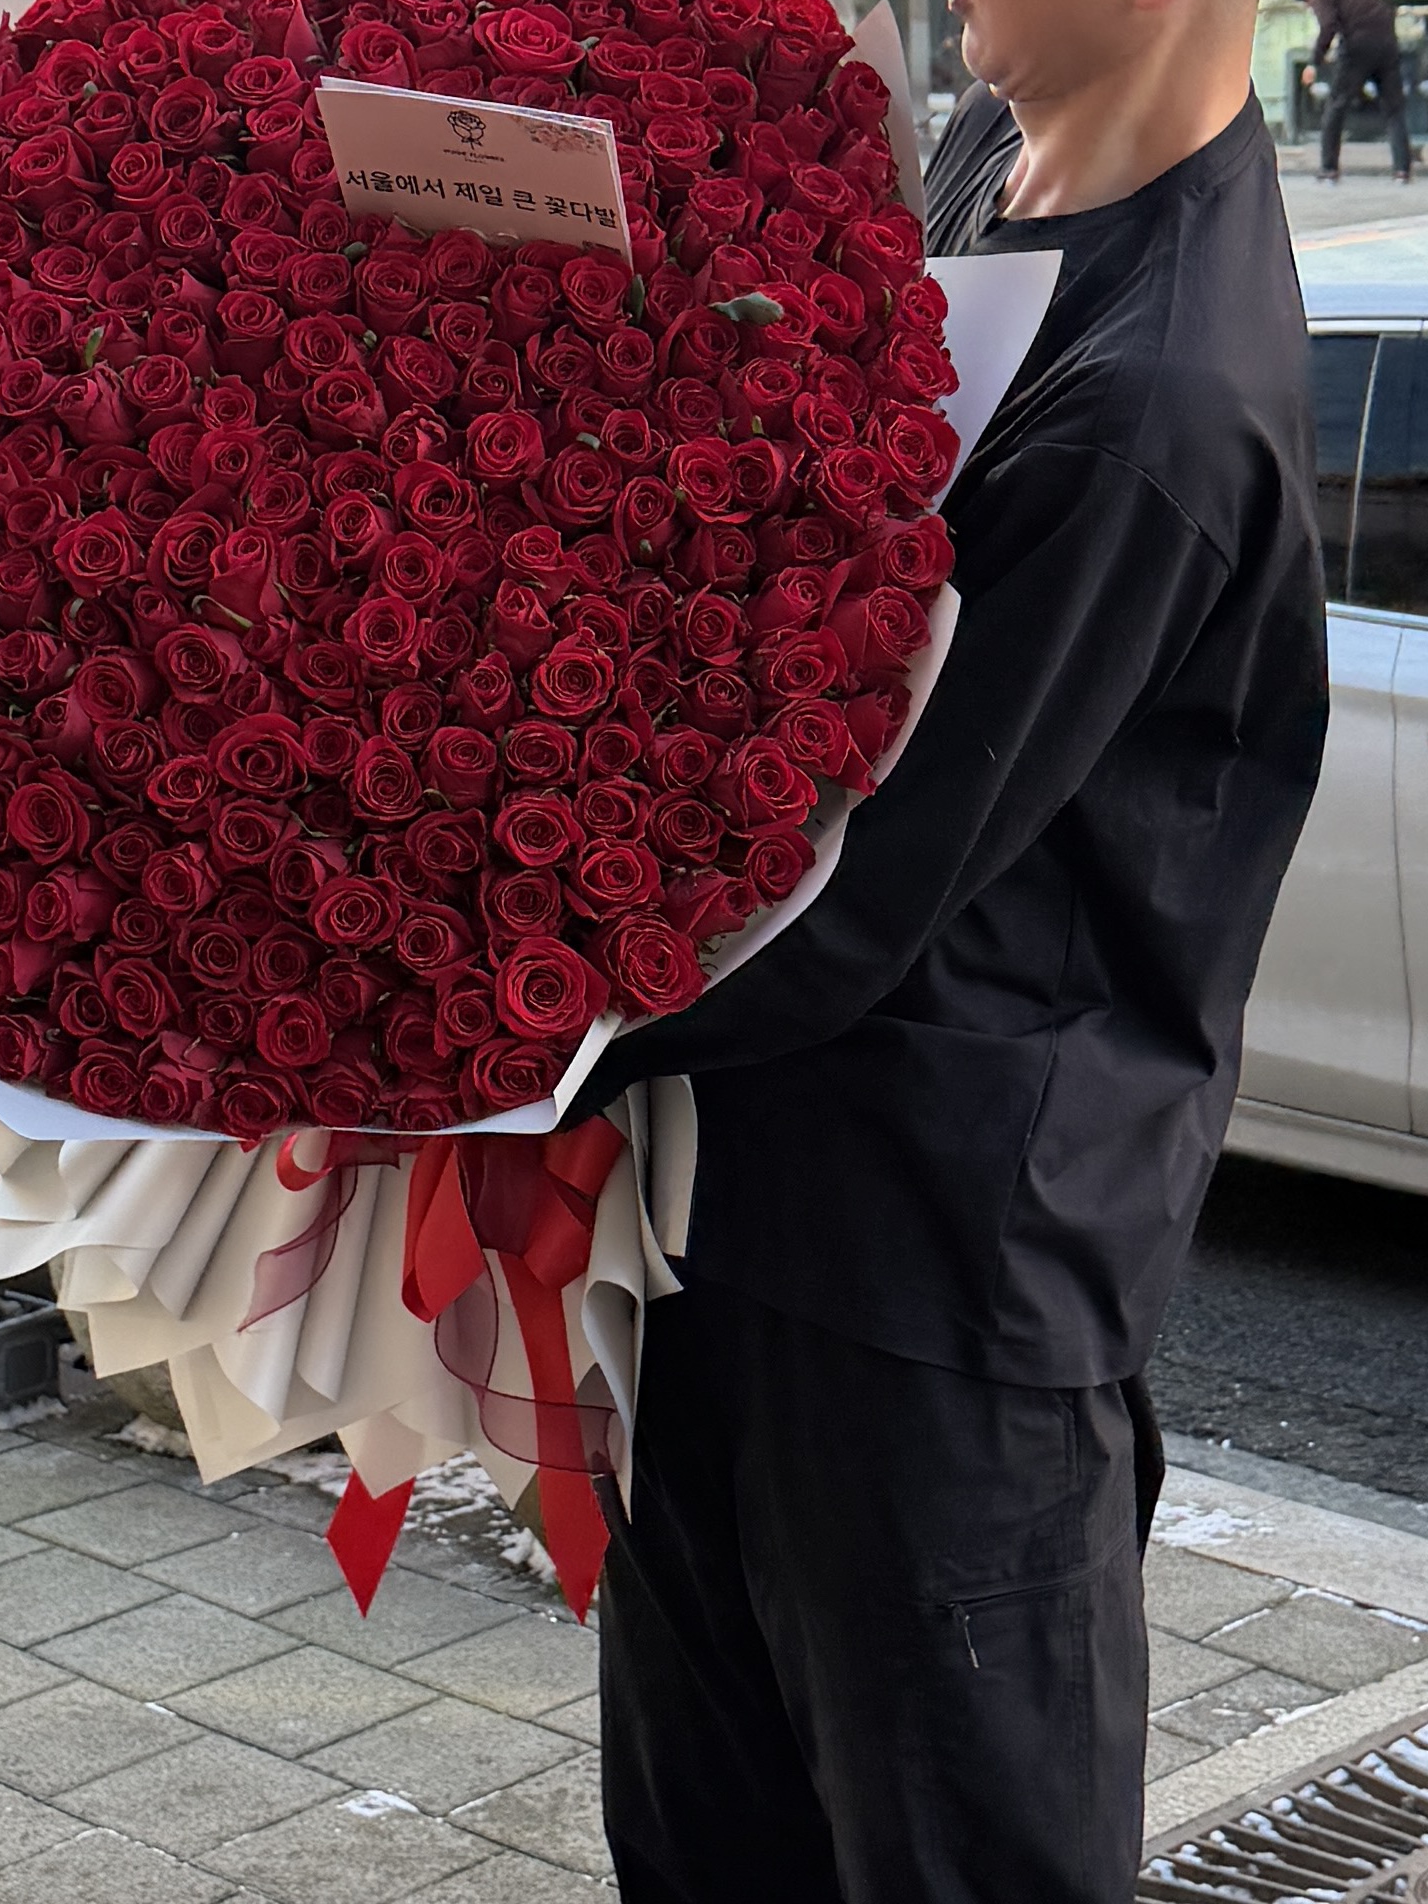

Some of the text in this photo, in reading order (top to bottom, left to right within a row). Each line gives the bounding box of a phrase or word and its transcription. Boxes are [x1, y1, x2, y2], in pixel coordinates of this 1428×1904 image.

[345, 169, 618, 230] 서울에서 제일 큰 꽃다발
